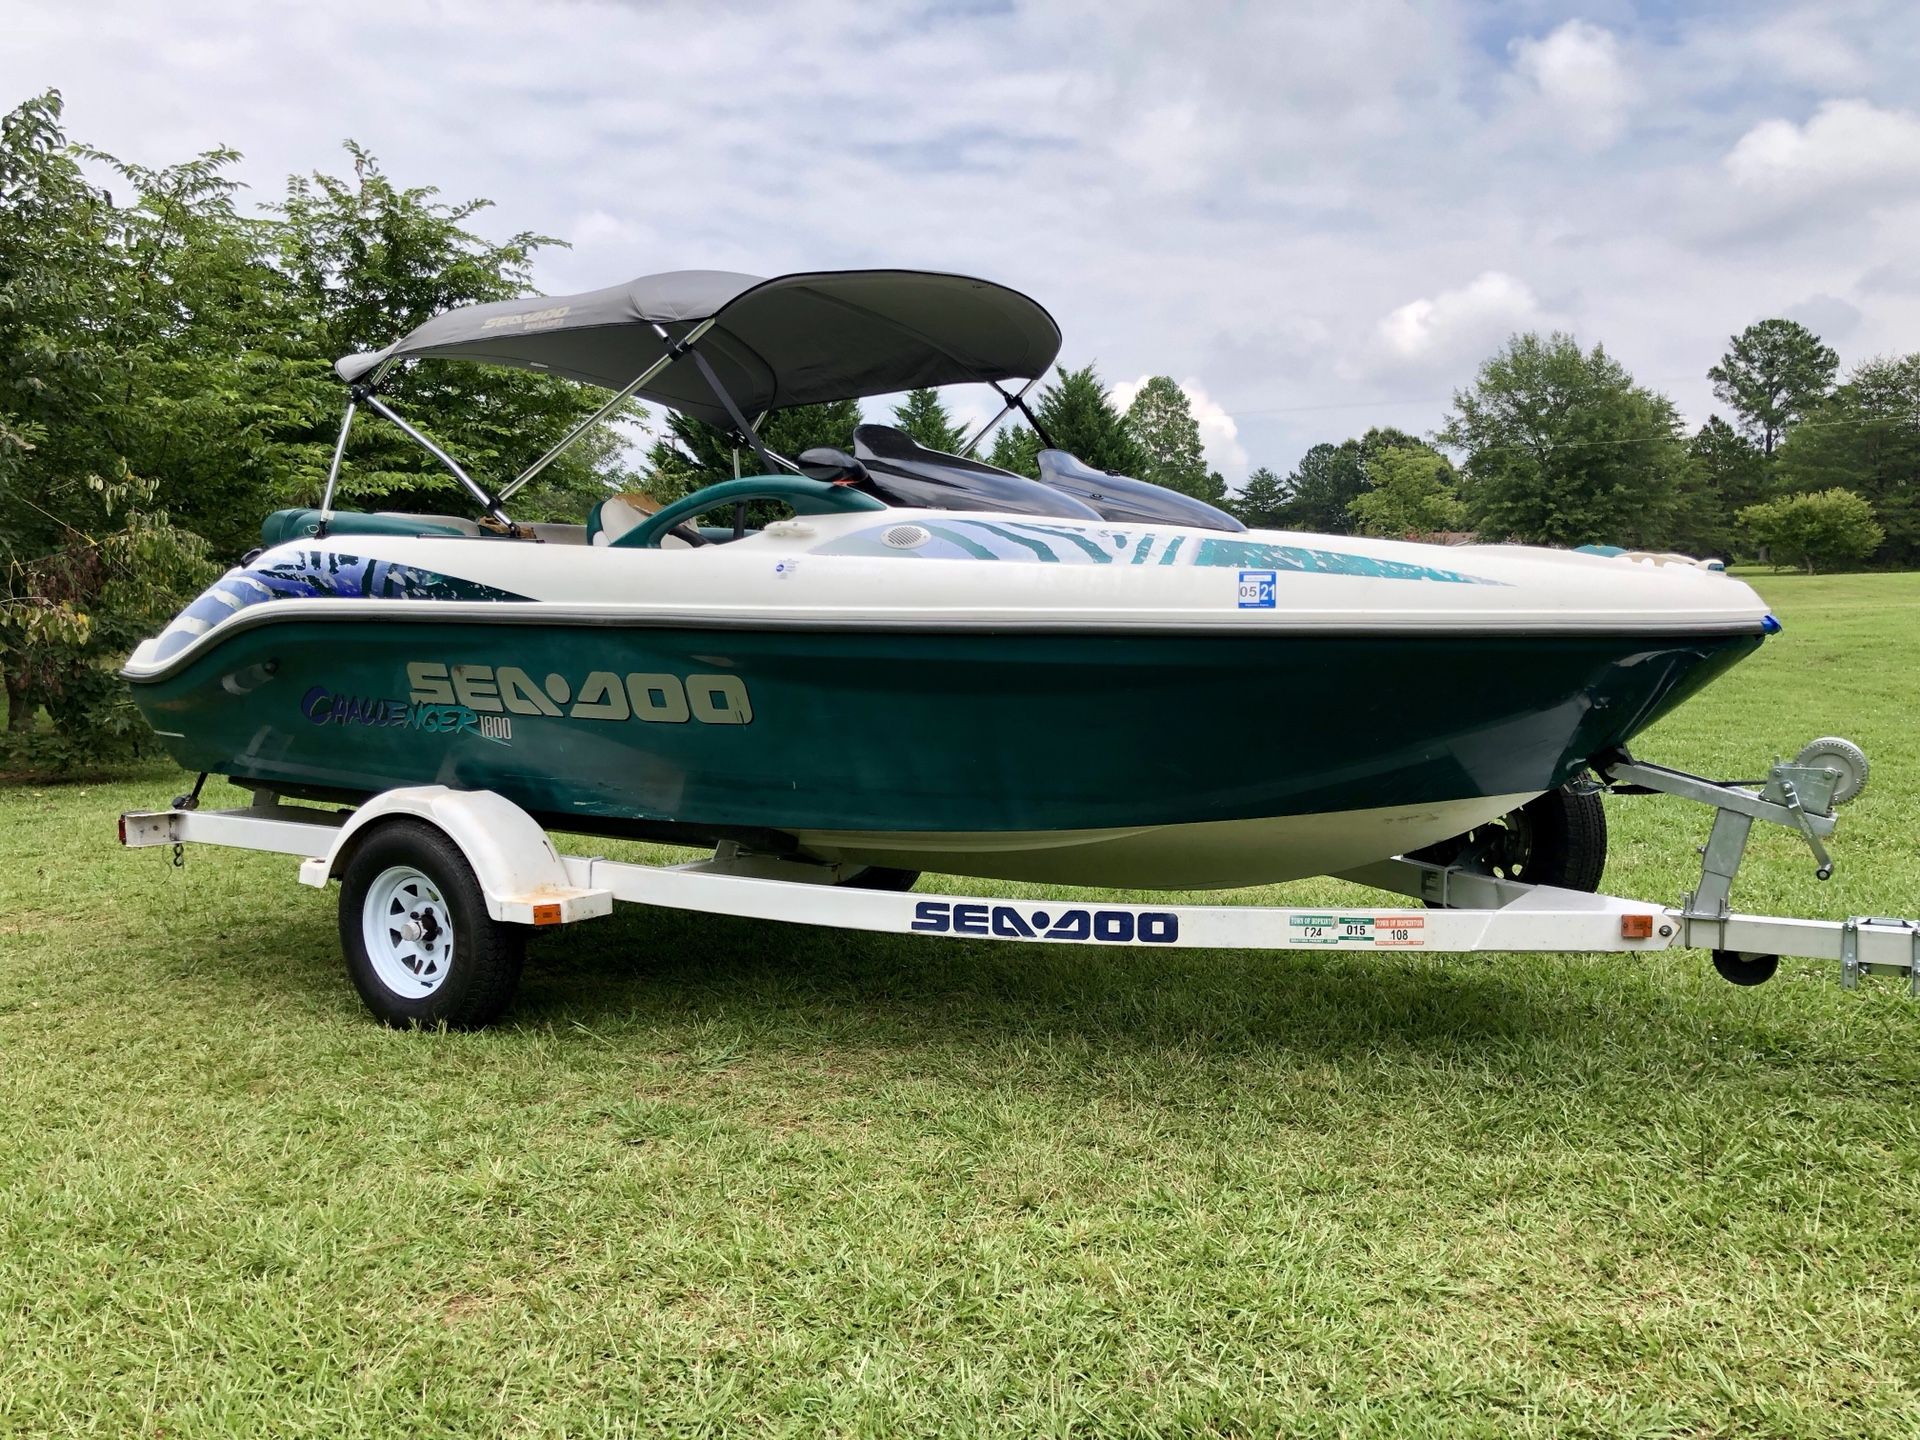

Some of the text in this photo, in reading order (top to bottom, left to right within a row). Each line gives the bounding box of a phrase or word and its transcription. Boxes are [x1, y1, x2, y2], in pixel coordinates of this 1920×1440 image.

[1240, 584, 1275, 600] 05 21
[302, 686, 512, 740] CHALLENGER 1800
[1346, 925, 1366, 935] 015
[1390, 929, 1409, 940] 108
